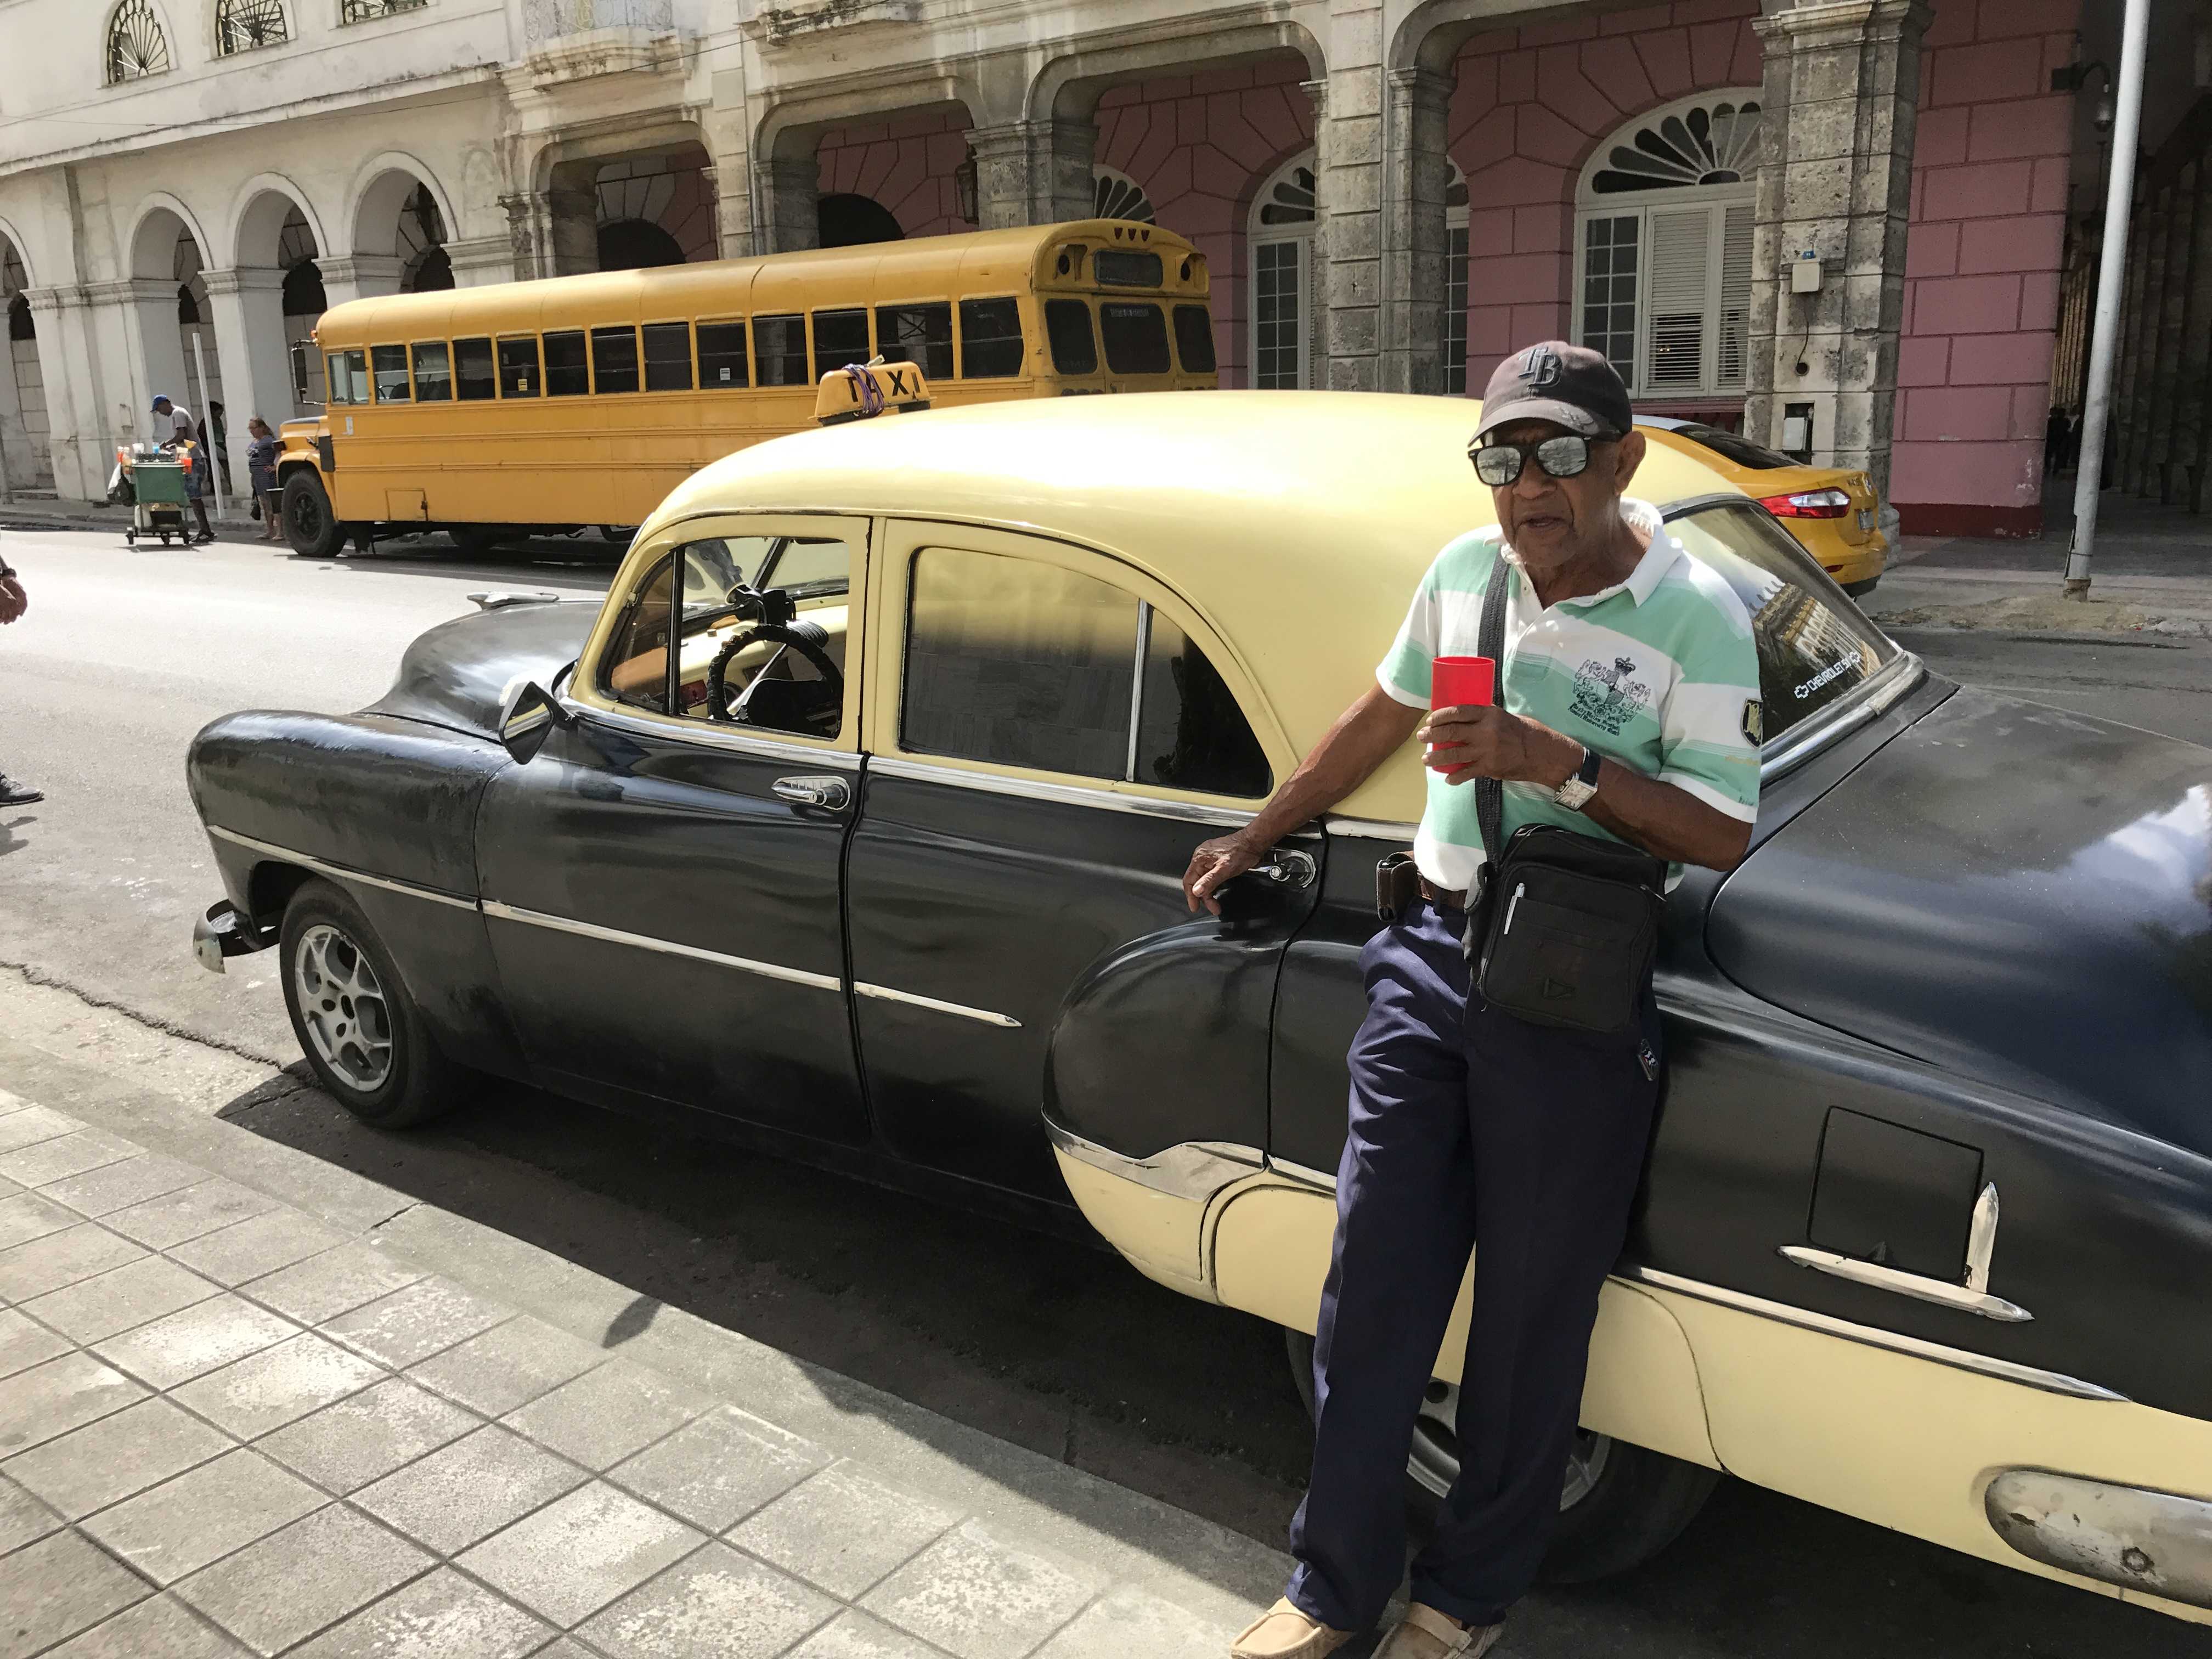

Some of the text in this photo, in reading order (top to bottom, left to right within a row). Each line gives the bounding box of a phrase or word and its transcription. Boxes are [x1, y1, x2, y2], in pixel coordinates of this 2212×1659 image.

[1518, 347, 1562, 387] TB
[844, 370, 921, 403] TAXI
[1806, 662, 1844, 691] CHEVROLET
